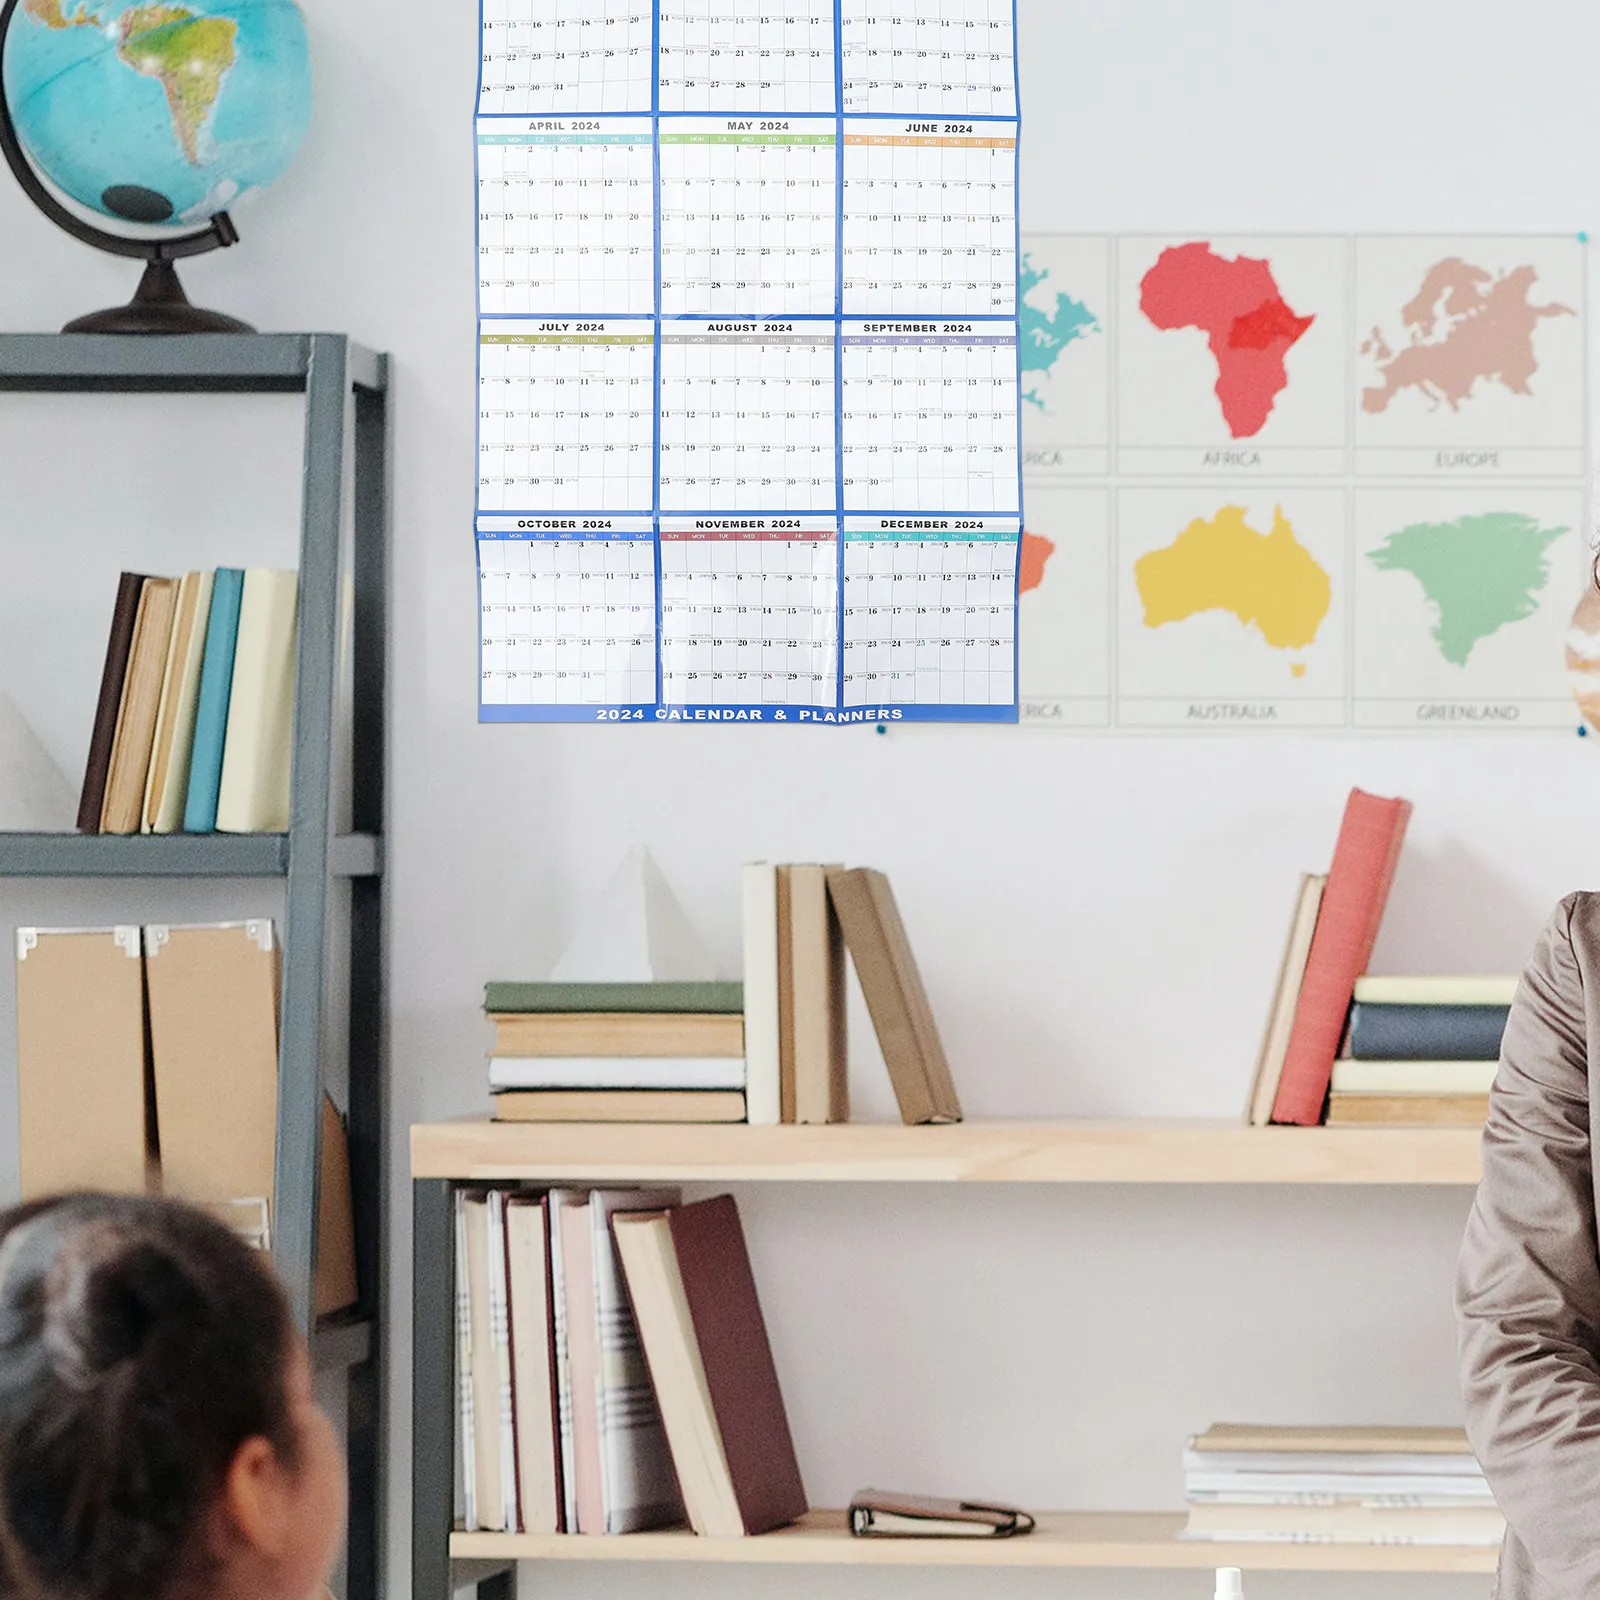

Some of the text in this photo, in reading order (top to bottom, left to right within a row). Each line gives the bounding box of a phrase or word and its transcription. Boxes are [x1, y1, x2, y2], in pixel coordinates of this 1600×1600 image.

[629, 48, 639, 56] 27
[529, 122, 601, 130] APRIL 2024
[728, 122, 789, 131] MAY 2024
[906, 124, 973, 133] JUNE 2024
[576, 323, 605, 332] 2024
[864, 324, 972, 333] SEPTEMBER 2024
[629, 411, 640, 419] 20
[1202, 450, 1261, 467] AFRICA
[1435, 451, 1501, 468] EUROPE
[710, 477, 721, 485] 27
[736, 478, 746, 486] 28
[761, 478, 771, 486] 29
[518, 520, 612, 529] OCTOBER 2024
[696, 520, 801, 529] NOVEMBER 2024
[881, 520, 984, 529] DECEMBER 2024
[1186, 702, 1278, 719] AUSTRALIA
[1416, 703, 1520, 720] GREENLAND
[596, 708, 903, 723] 2024 CALENDAR & PLANNERS
